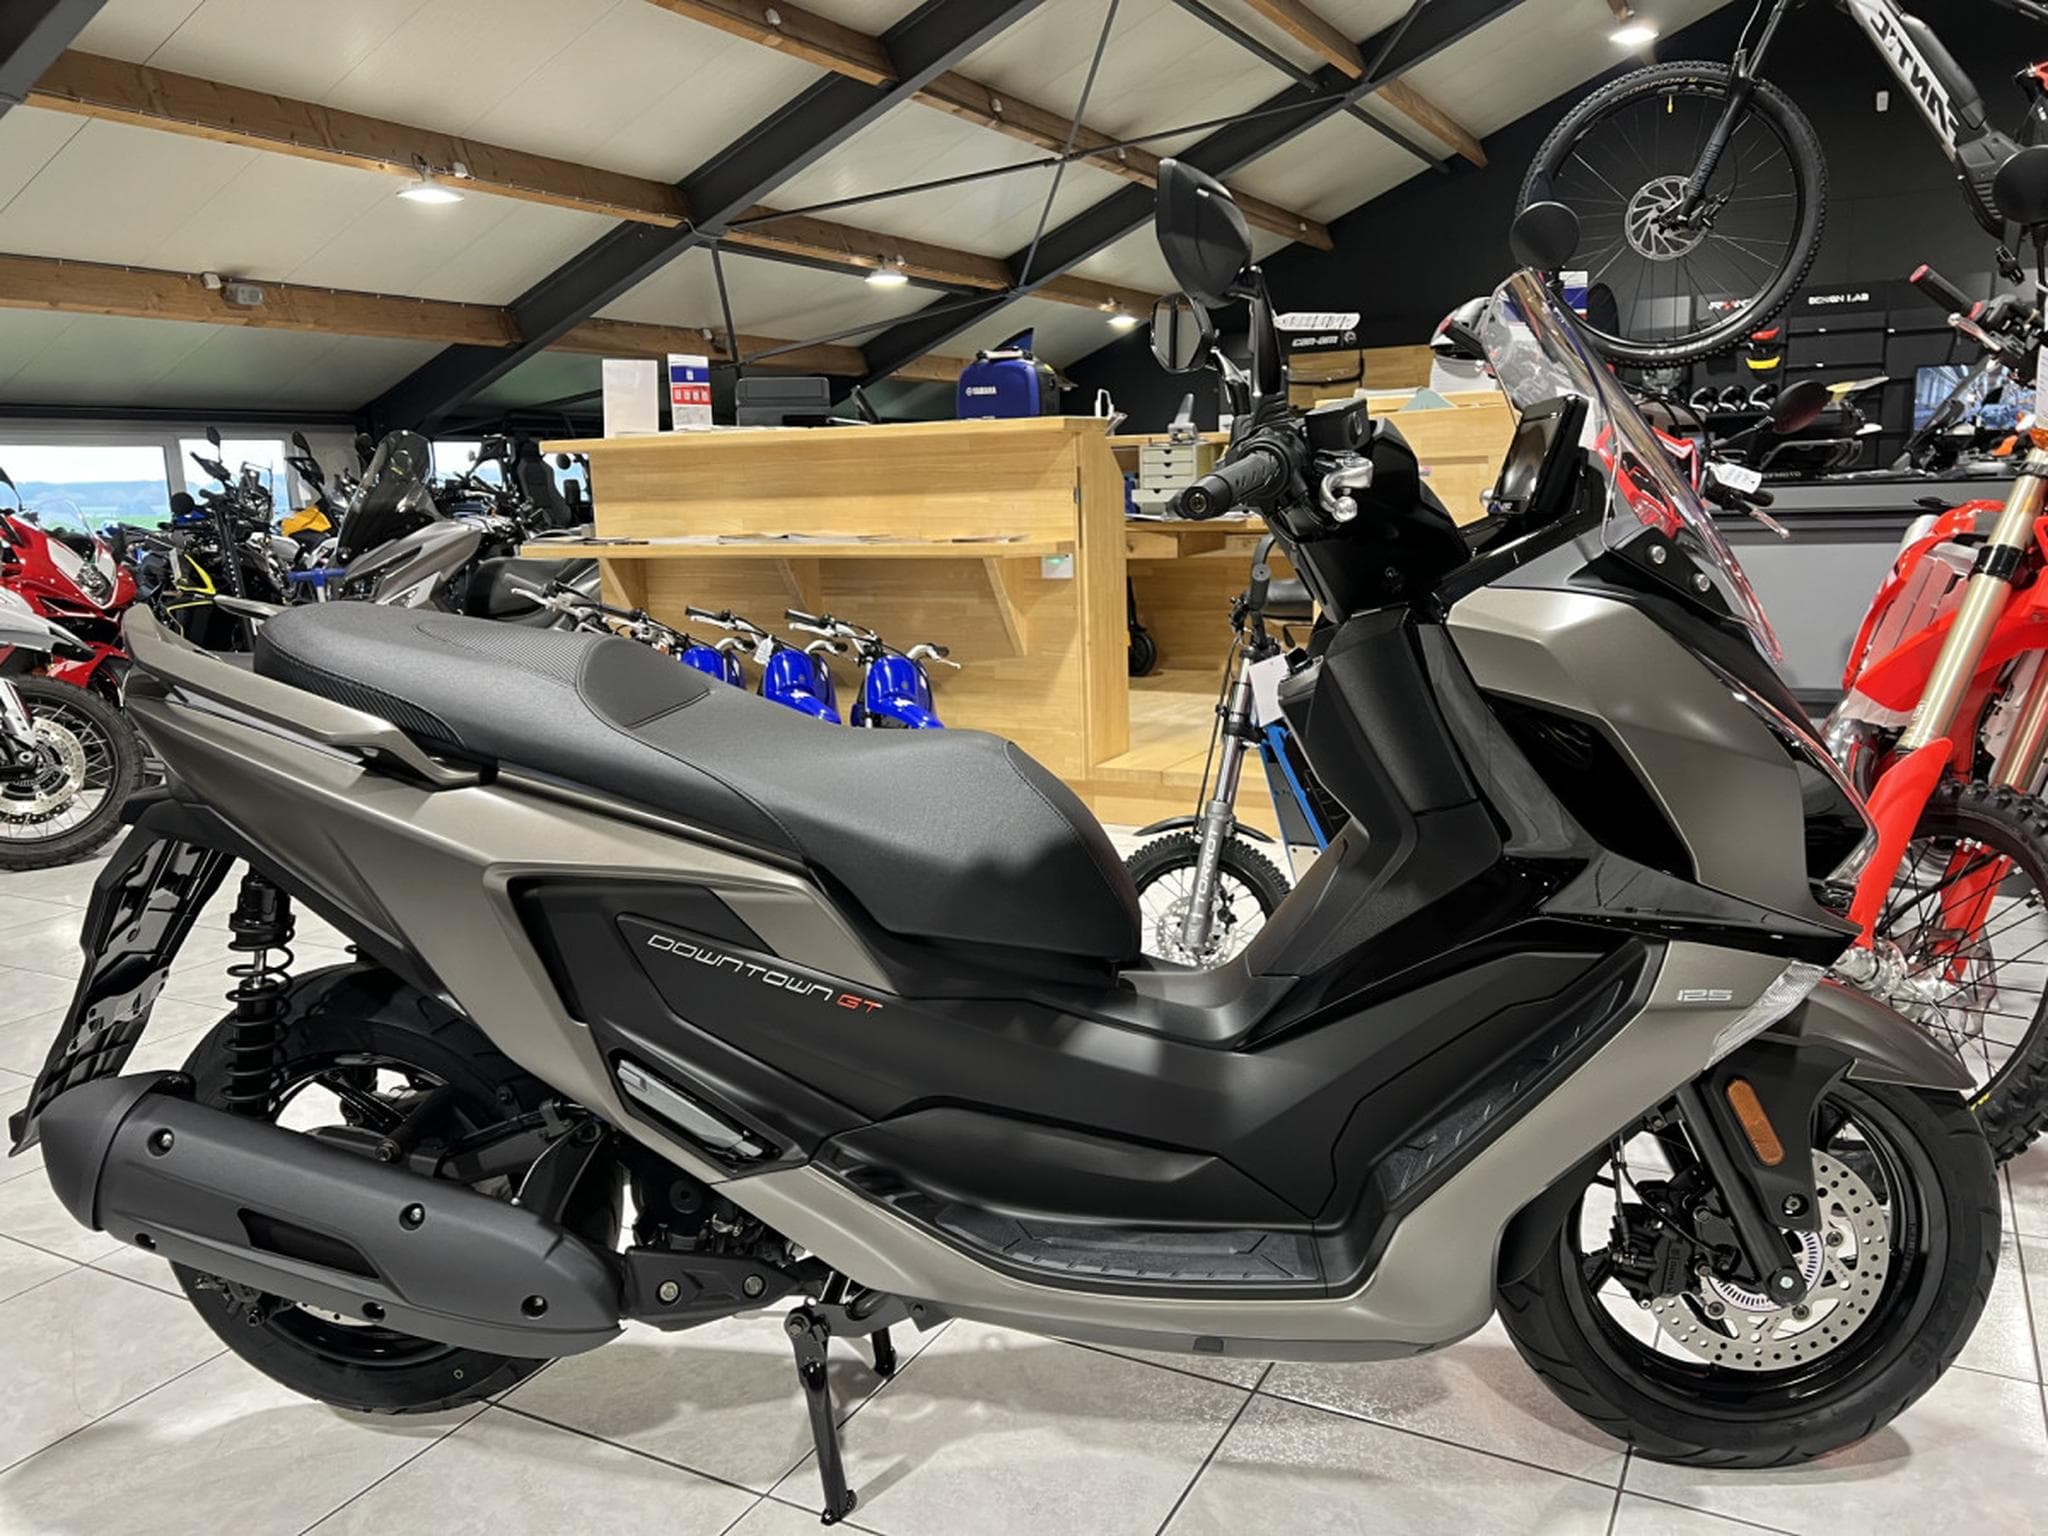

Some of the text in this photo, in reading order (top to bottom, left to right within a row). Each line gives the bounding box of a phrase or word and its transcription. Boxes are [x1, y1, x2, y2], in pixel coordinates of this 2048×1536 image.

[1195, 828, 1219, 905] TORROT
[647, 934, 883, 1014] DOWNTOWN GT
[1677, 988, 1734, 1002] 125
